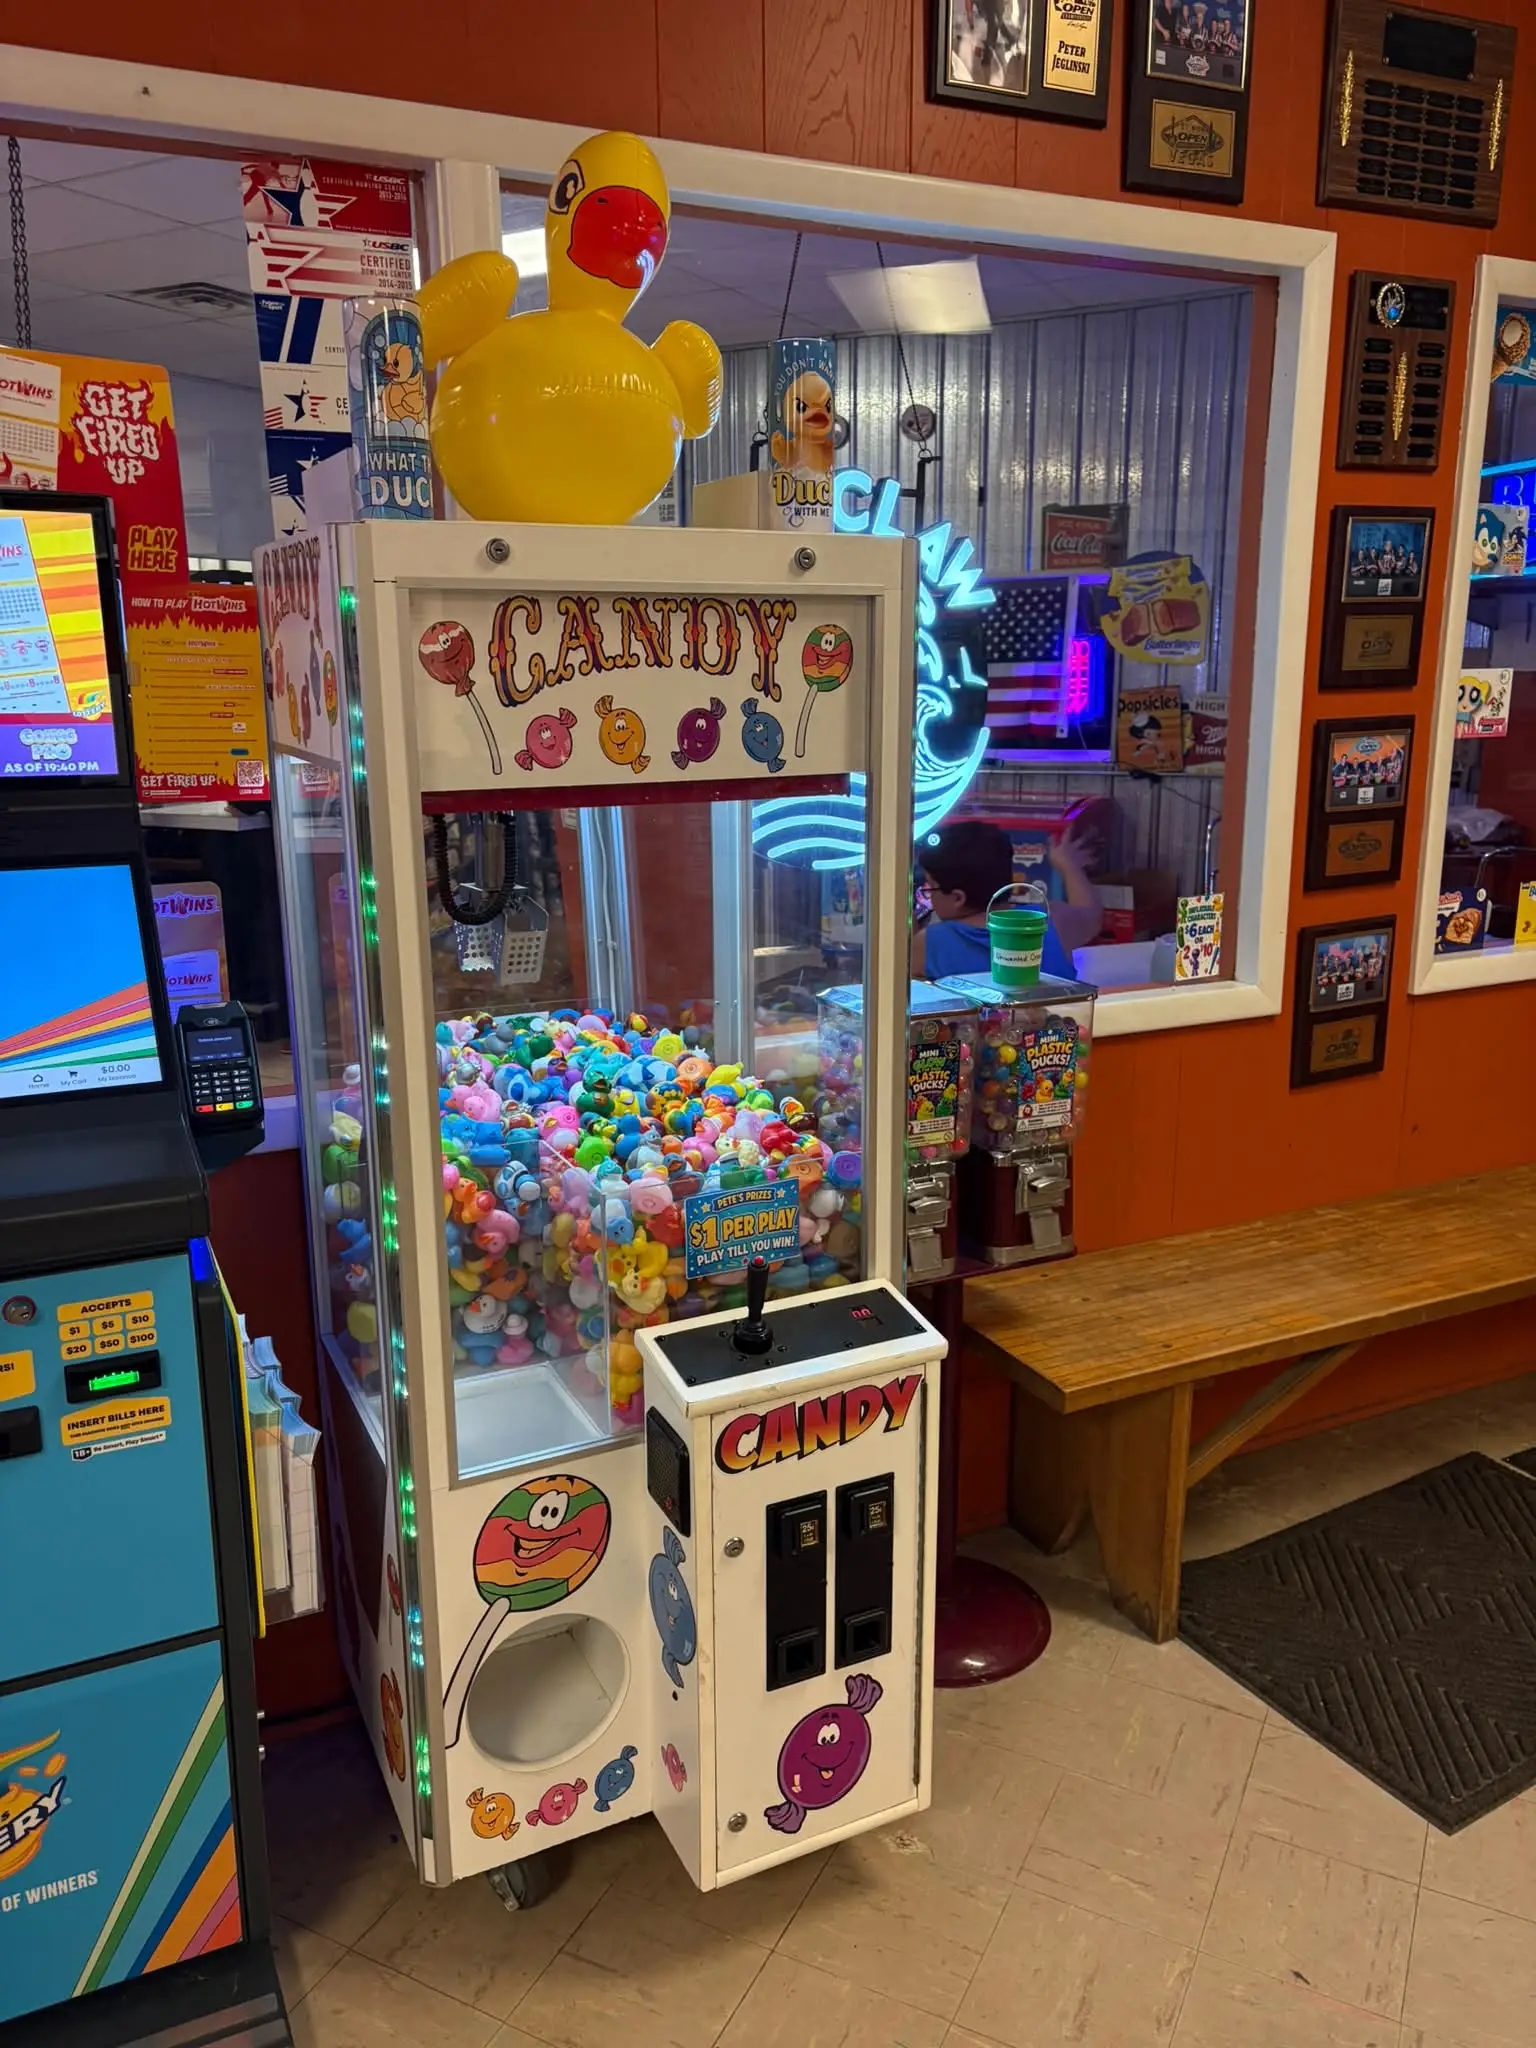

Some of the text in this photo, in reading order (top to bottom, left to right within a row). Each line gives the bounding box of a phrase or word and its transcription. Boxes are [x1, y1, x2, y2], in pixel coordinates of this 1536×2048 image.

[1063, 3, 1094, 15] OPEN
[1058, 40, 1086, 57] PETER
[372, 241, 409, 251] USBC
[360, 255, 411, 270] CERTIFIED
[81, 383, 149, 419] GET
[104, 456, 145, 485] UP
[369, 452, 416, 472] WHAT
[370, 476, 433, 508] DUC
[794, 506, 817, 517] WITH
[129, 526, 177, 549] PLAY
[128, 549, 177, 572] HERE
[131, 598, 151, 608] HOW
[165, 599, 188, 609] PLAY
[489, 595, 796, 706] CANDY
[4, 761, 100, 773] AS OF 19:40 PM
[1183, 945, 1191, 960] 2
[920, 1049, 939, 1059] MINI
[1027, 1042, 1073, 1060] PLASTIC
[101, 1064, 130, 1074] $0.00
[1031, 1055, 1071, 1069] DUCKS!
[909, 1071, 950, 1085] PLASTIC
[914, 1080, 947, 1092] DUCKS!
[717, 1189, 772, 1209] PETE'S PRIZES
[690, 1207, 797, 1249] $1 PER PLAY
[697, 1236, 795, 1266] PLAY TILL YOU WIN!
[81, 1299, 131, 1314] ACCEPTS
[69, 1315, 149, 1335] $1 $5 $10
[66, 1332, 154, 1355] $20 $50 $100
[67, 1404, 165, 1430] INSERT BILLS HERE
[715, 1374, 923, 1474] CANDY
[74, 1448, 90, 1458] 18+
[1, 1870, 98, 1912] OF WINNERS
